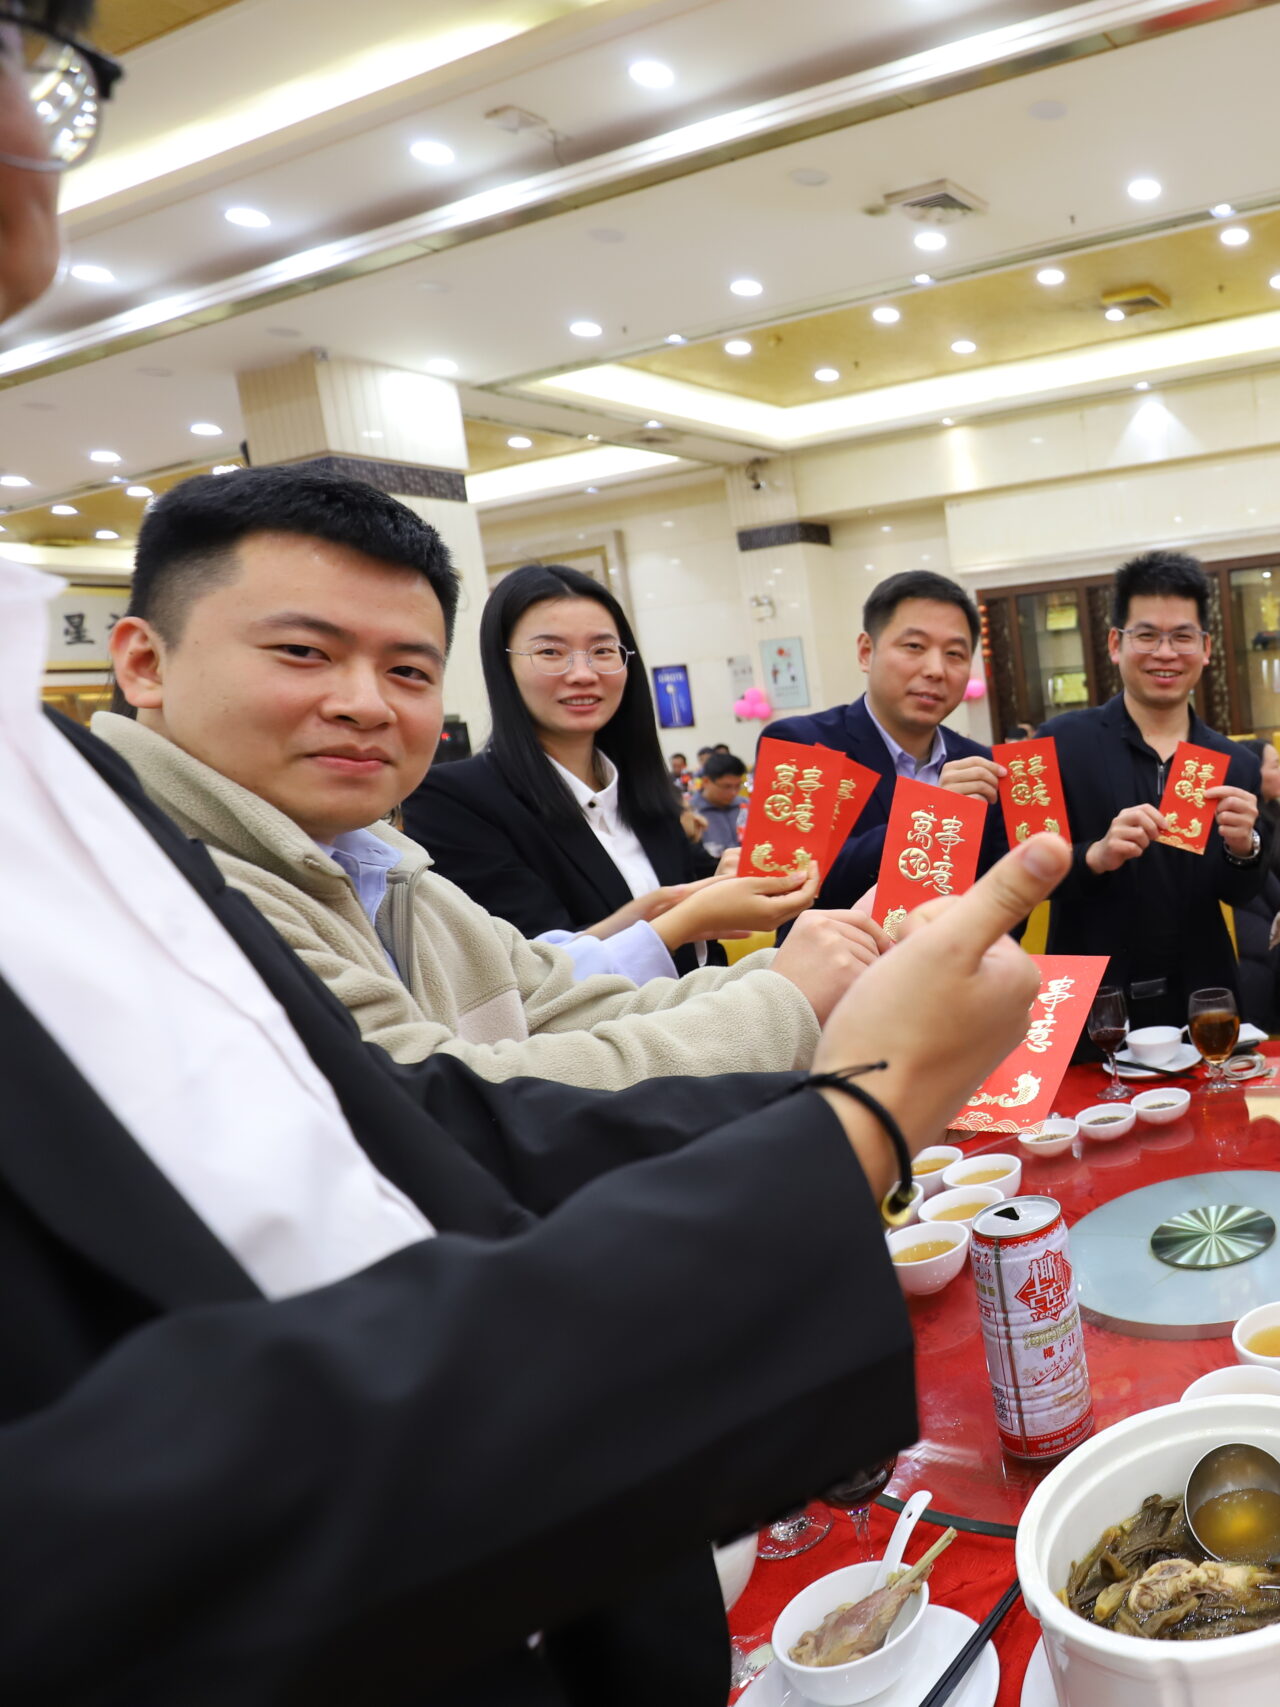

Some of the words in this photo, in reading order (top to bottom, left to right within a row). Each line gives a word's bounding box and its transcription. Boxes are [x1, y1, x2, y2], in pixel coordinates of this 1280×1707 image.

[771, 762, 824, 797] 萬事
[1009, 754, 1047, 784] 萬事
[1181, 760, 1215, 785] 萬事
[1011, 780, 1052, 806] 如意
[1175, 780, 1206, 808] 如意
[764, 794, 815, 832] 如意
[907, 810, 965, 854] 萬事
[899, 848, 954, 895] 如意
[1037, 975, 1076, 1013] 事
[1020, 1013, 1057, 1053] 意
